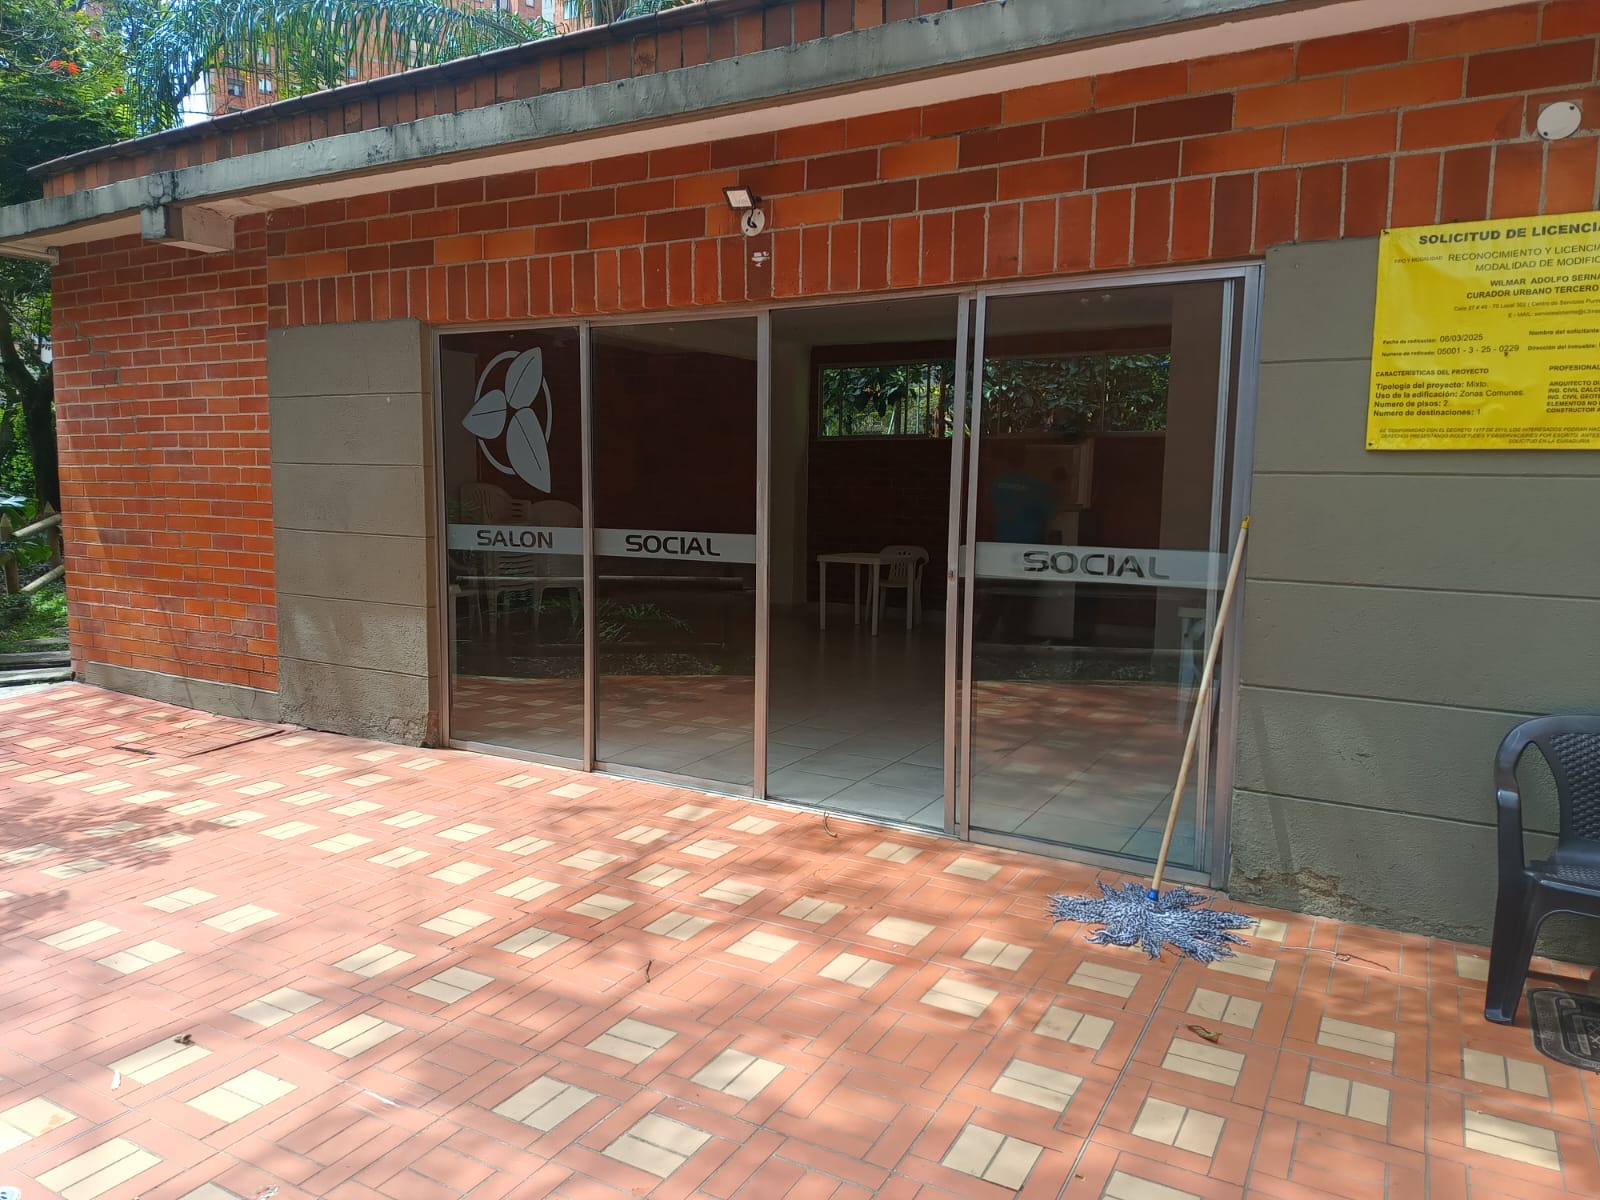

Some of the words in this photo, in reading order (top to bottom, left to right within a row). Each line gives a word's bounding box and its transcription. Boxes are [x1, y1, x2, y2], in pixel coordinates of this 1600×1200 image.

[1419, 230, 1500, 245] SOLICITUD
[1506, 227, 1527, 239] DE
[1532, 221, 1600, 237] LICENCI
[1448, 247, 1542, 262] RECONOCIMIENTO
[1545, 247, 1553, 255] Y
[1475, 260, 1537, 272] MODALIDAD
[1539, 258, 1554, 268] DE
[1490, 278, 1526, 287] WILMAR
[1531, 275, 1569, 285] ADOLFO
[1466, 289, 1511, 299] CURADOR
[1513, 287, 1552, 297] URBANO
[1554, 284, 1600, 294] TERCERO
[1468, 346, 1474, 354] 3
[1481, 345, 1491, 353] 25
[1436, 368, 1450, 376] DEL
[1451, 367, 1489, 375] PROYECTO
[1412, 381, 1425, 389] del
[1375, 391, 1391, 399] Uso
[1392, 391, 1402, 399] de
[1403, 390, 1411, 398] la
[1459, 389, 1484, 398] Zonas
[1405, 400, 1415, 408] de
[1443, 399, 1449, 407] 2
[477, 529, 553, 549] SALON
[625, 534, 721, 556] SOCIAL
[1023, 550, 1170, 580] SOCIAL
